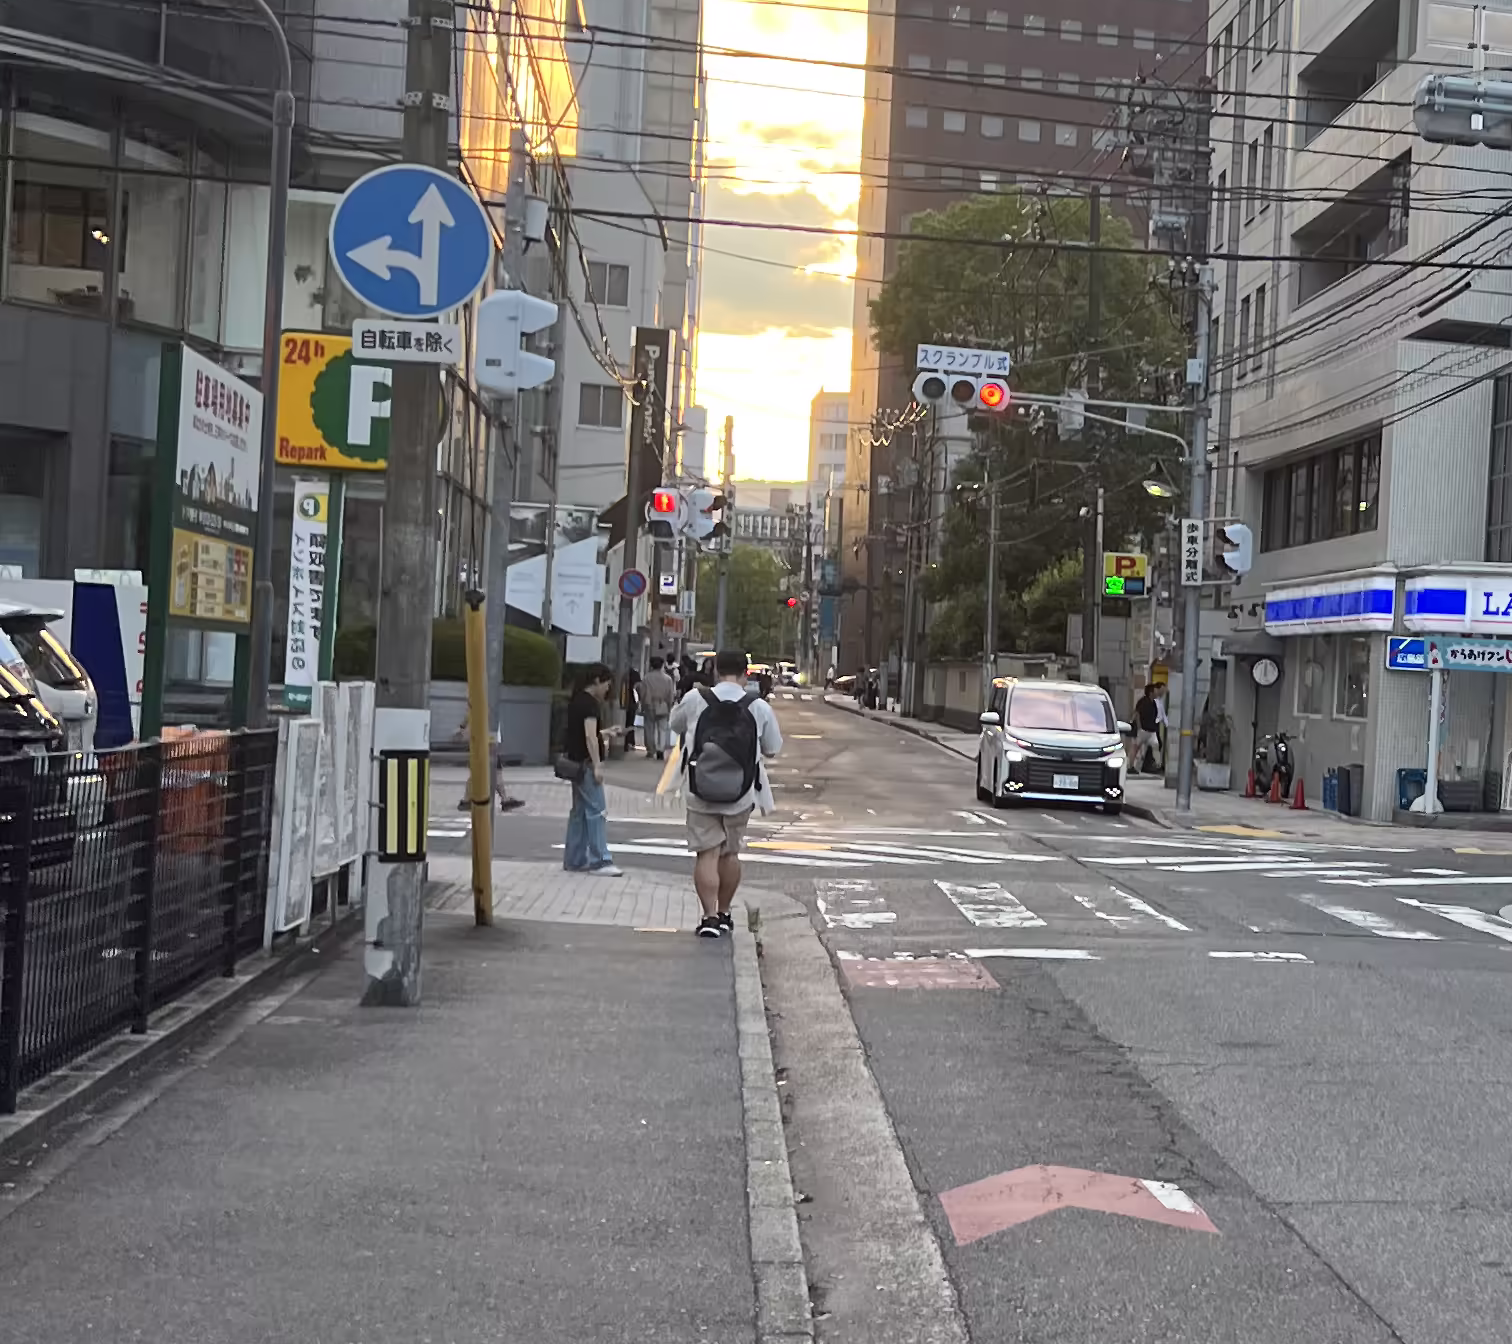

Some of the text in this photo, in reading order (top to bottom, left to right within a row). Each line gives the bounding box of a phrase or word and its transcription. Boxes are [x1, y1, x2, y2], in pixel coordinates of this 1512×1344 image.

[361, 328, 453, 354] 自転車を除く
[919, 349, 1008, 371] スクランブル式
[279, 437, 327, 461] Repark
[1185, 522, 1199, 582] 歩車分離式
